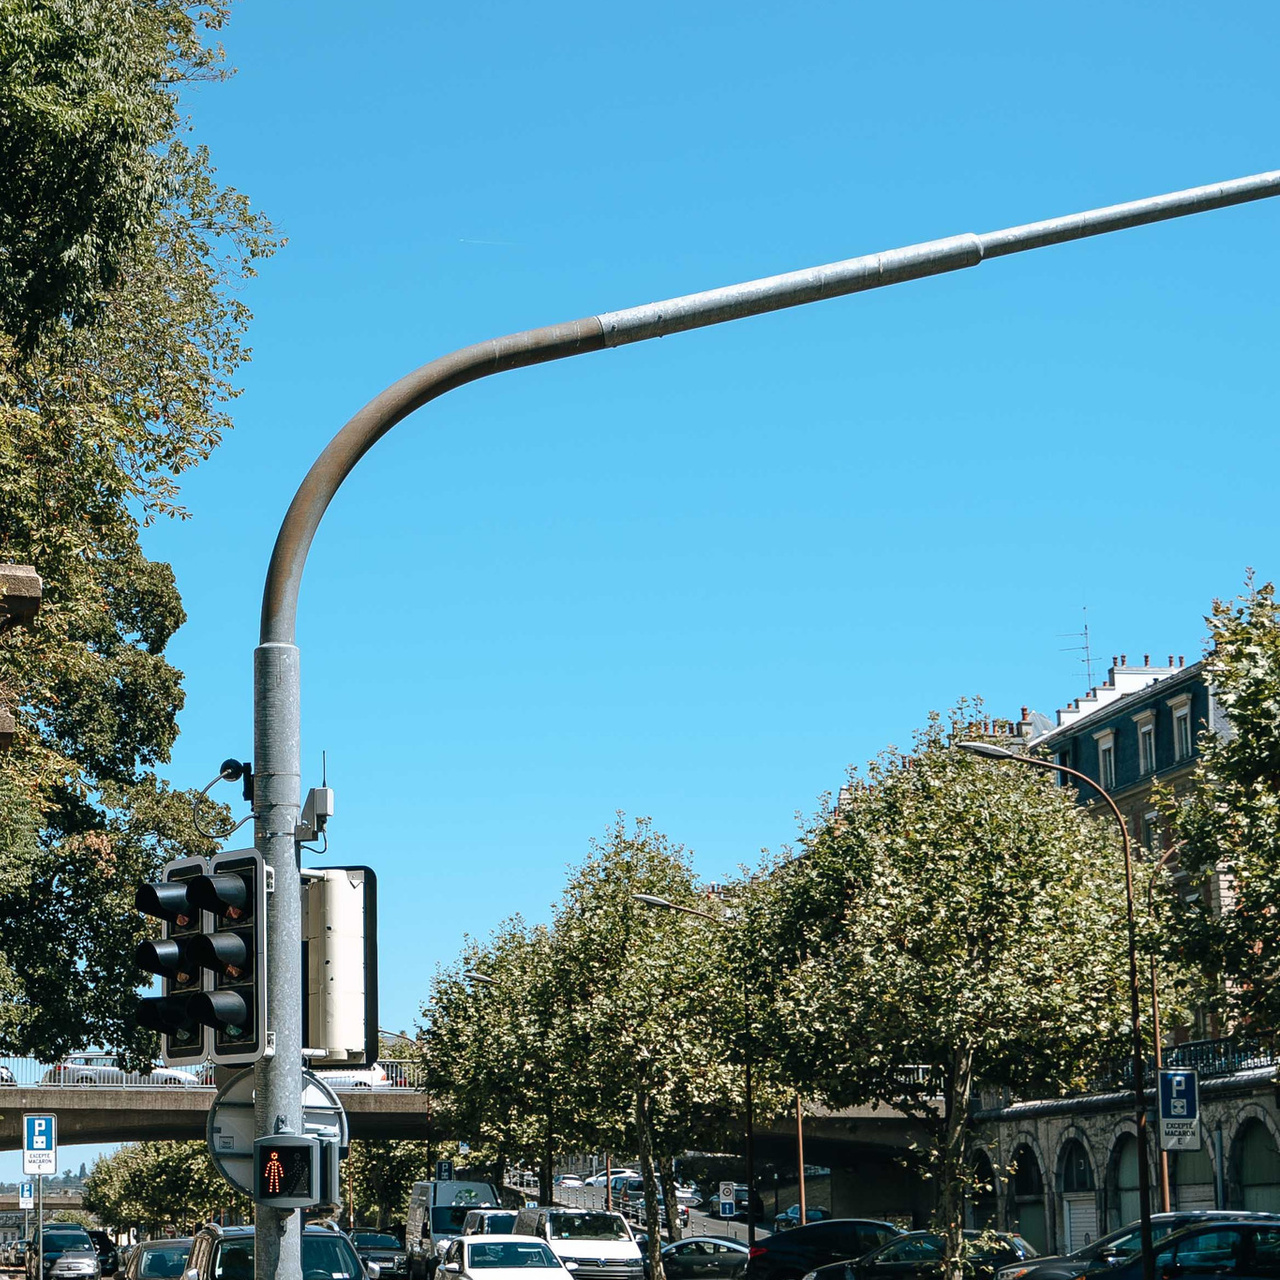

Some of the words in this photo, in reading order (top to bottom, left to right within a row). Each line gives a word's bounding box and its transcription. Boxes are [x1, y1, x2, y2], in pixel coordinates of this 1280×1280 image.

[1172, 1076, 1186, 1098] P
[34, 1119, 46, 1136] P
[442, 1163, 449, 1172] P
